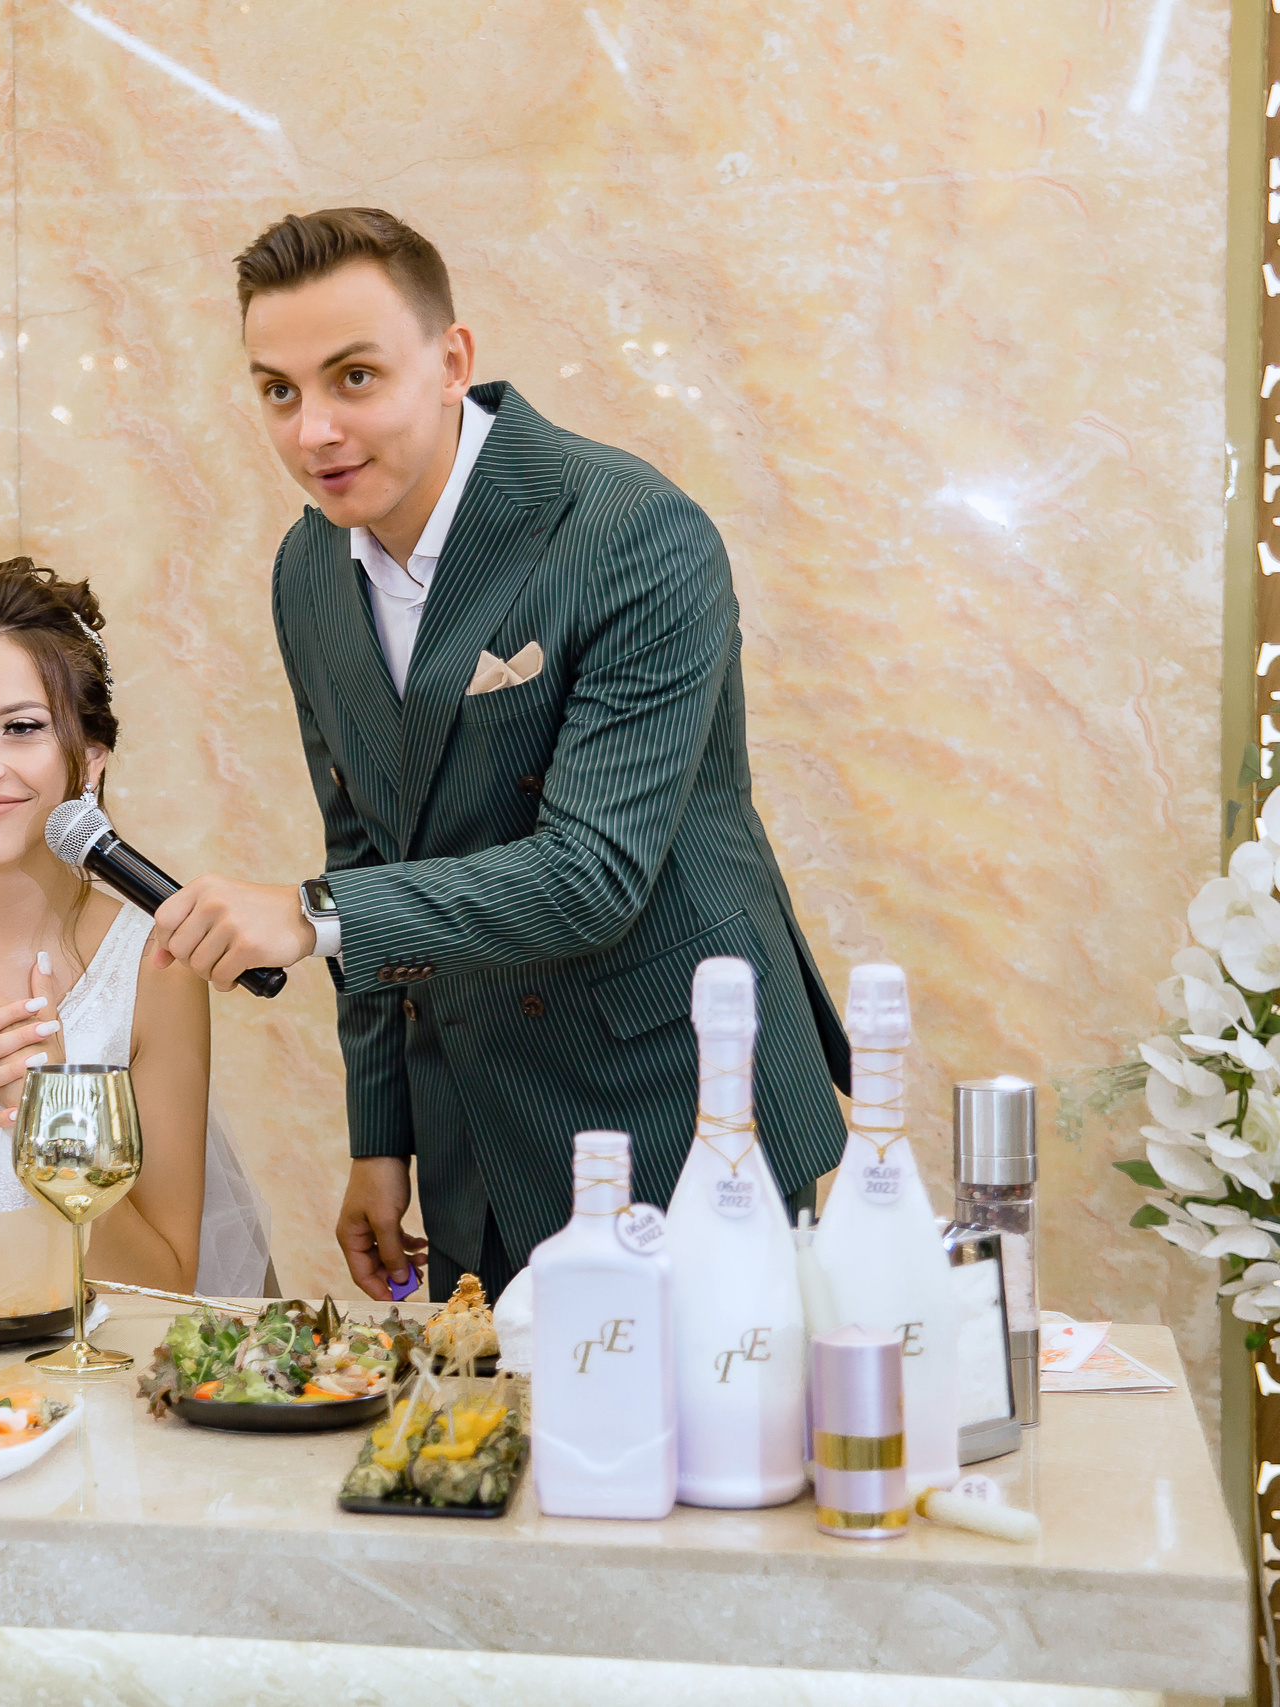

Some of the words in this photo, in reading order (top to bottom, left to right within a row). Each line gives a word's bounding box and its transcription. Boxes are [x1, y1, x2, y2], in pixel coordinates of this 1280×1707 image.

[865, 1180, 899, 1194] 2022
[718, 1194, 752, 1208] 2022
[635, 1224, 665, 1247] 2022
